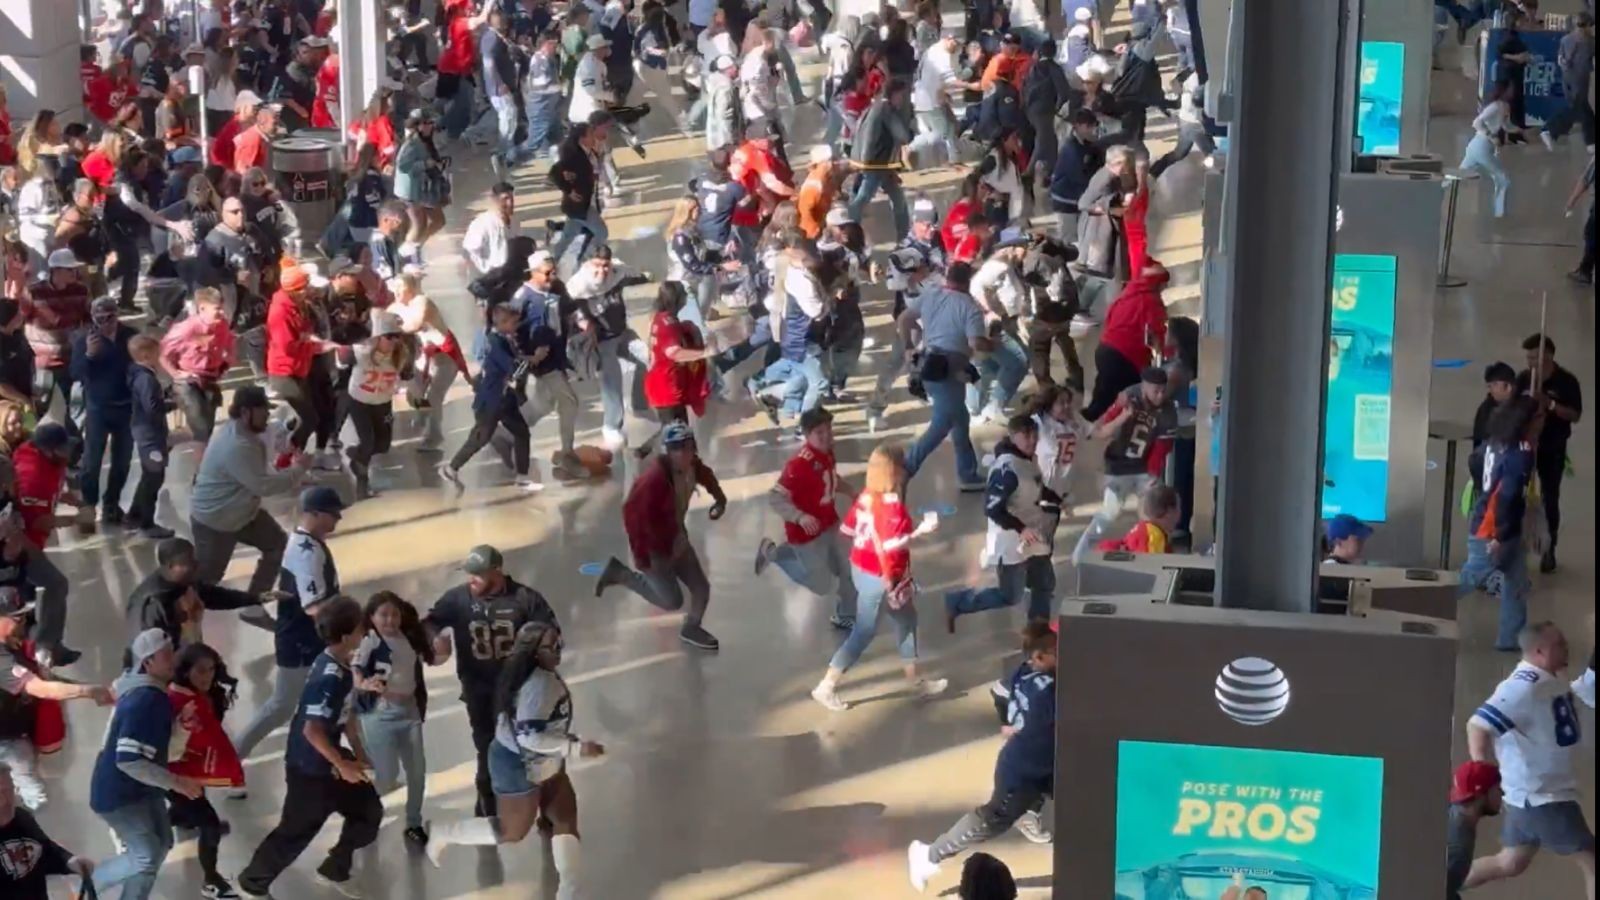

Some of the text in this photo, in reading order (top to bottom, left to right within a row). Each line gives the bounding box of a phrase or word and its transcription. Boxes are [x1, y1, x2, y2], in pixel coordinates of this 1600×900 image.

[1125, 424, 1149, 459] 5
[306, 579, 317, 596] 4
[468, 619, 515, 660] 82
[1182, 782, 1323, 803] POSE WITH THE
[1172, 798, 1320, 844] PROS
